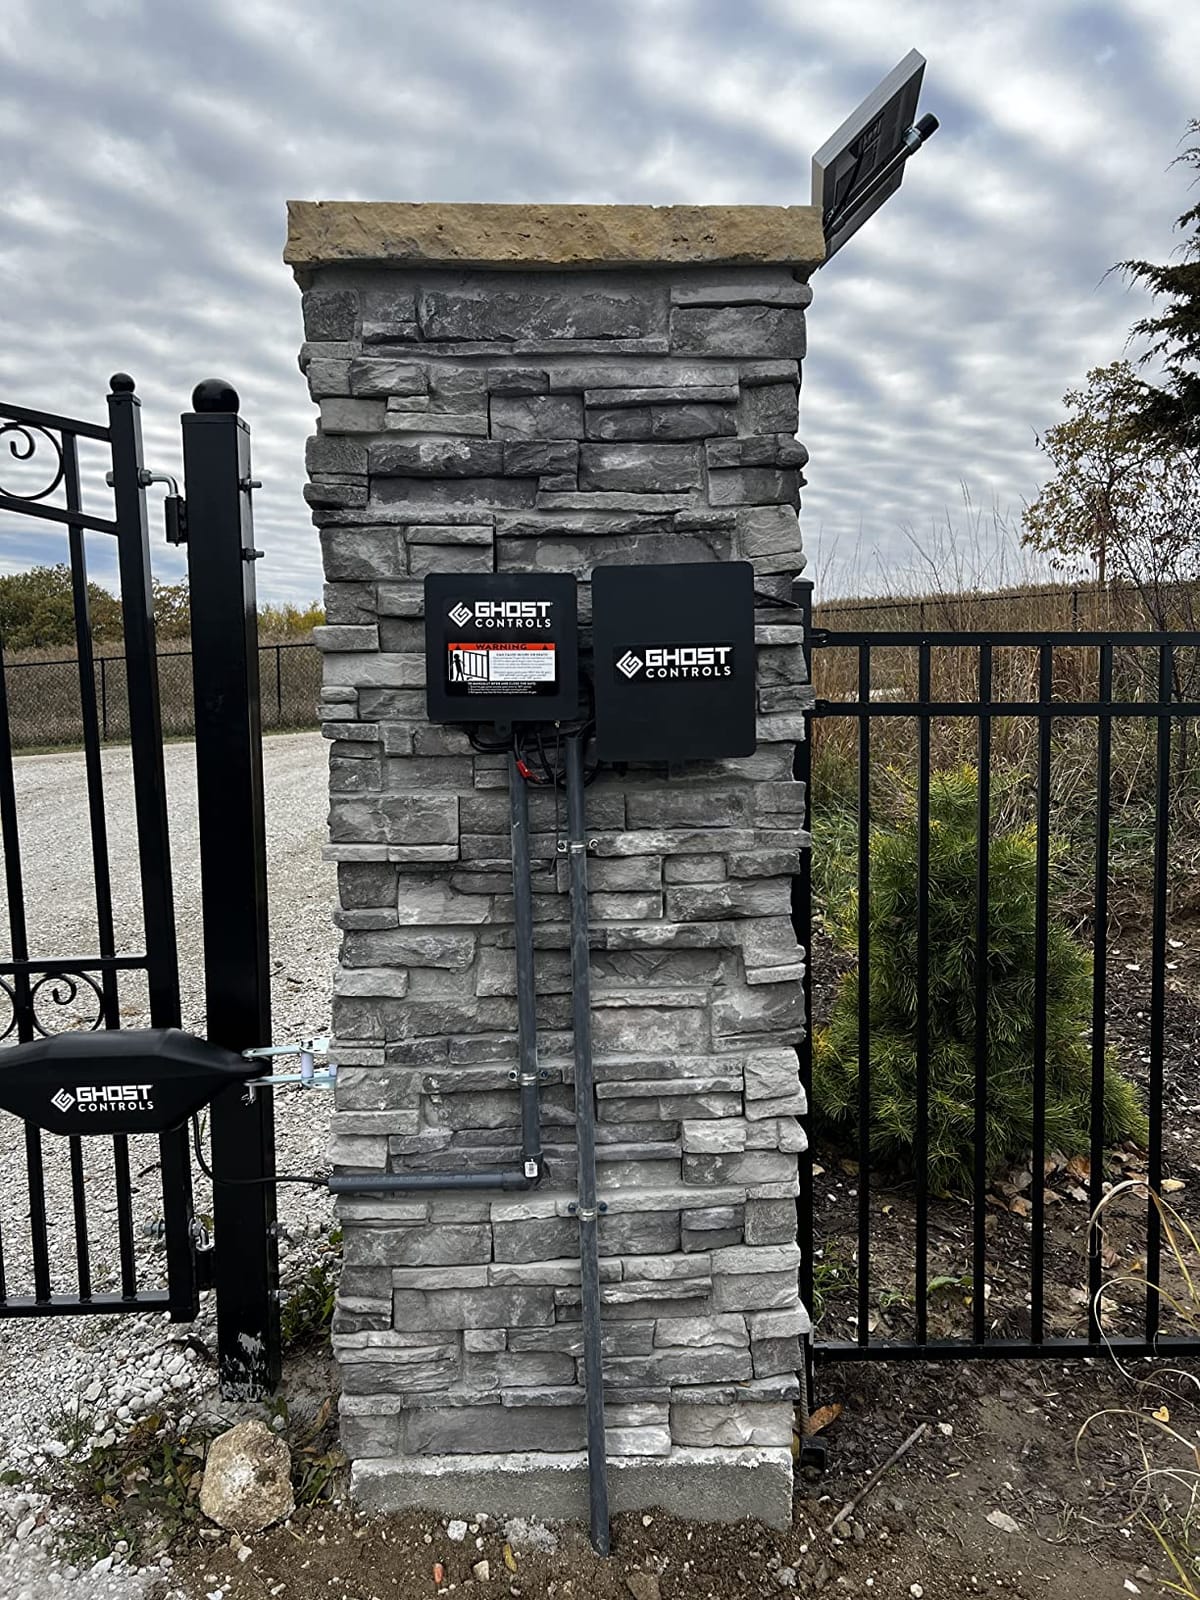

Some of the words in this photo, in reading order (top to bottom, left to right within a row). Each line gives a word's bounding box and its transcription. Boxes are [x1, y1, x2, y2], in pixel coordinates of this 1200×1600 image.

[475, 602, 552, 617] GHOST
[475, 618, 551, 628] CONTROLS
[646, 647, 732, 666] GHOST
[646, 666, 731, 678] CONTROLS
[76, 1085, 152, 1102] GHOST
[78, 1102, 154, 1112] CONTROLS
